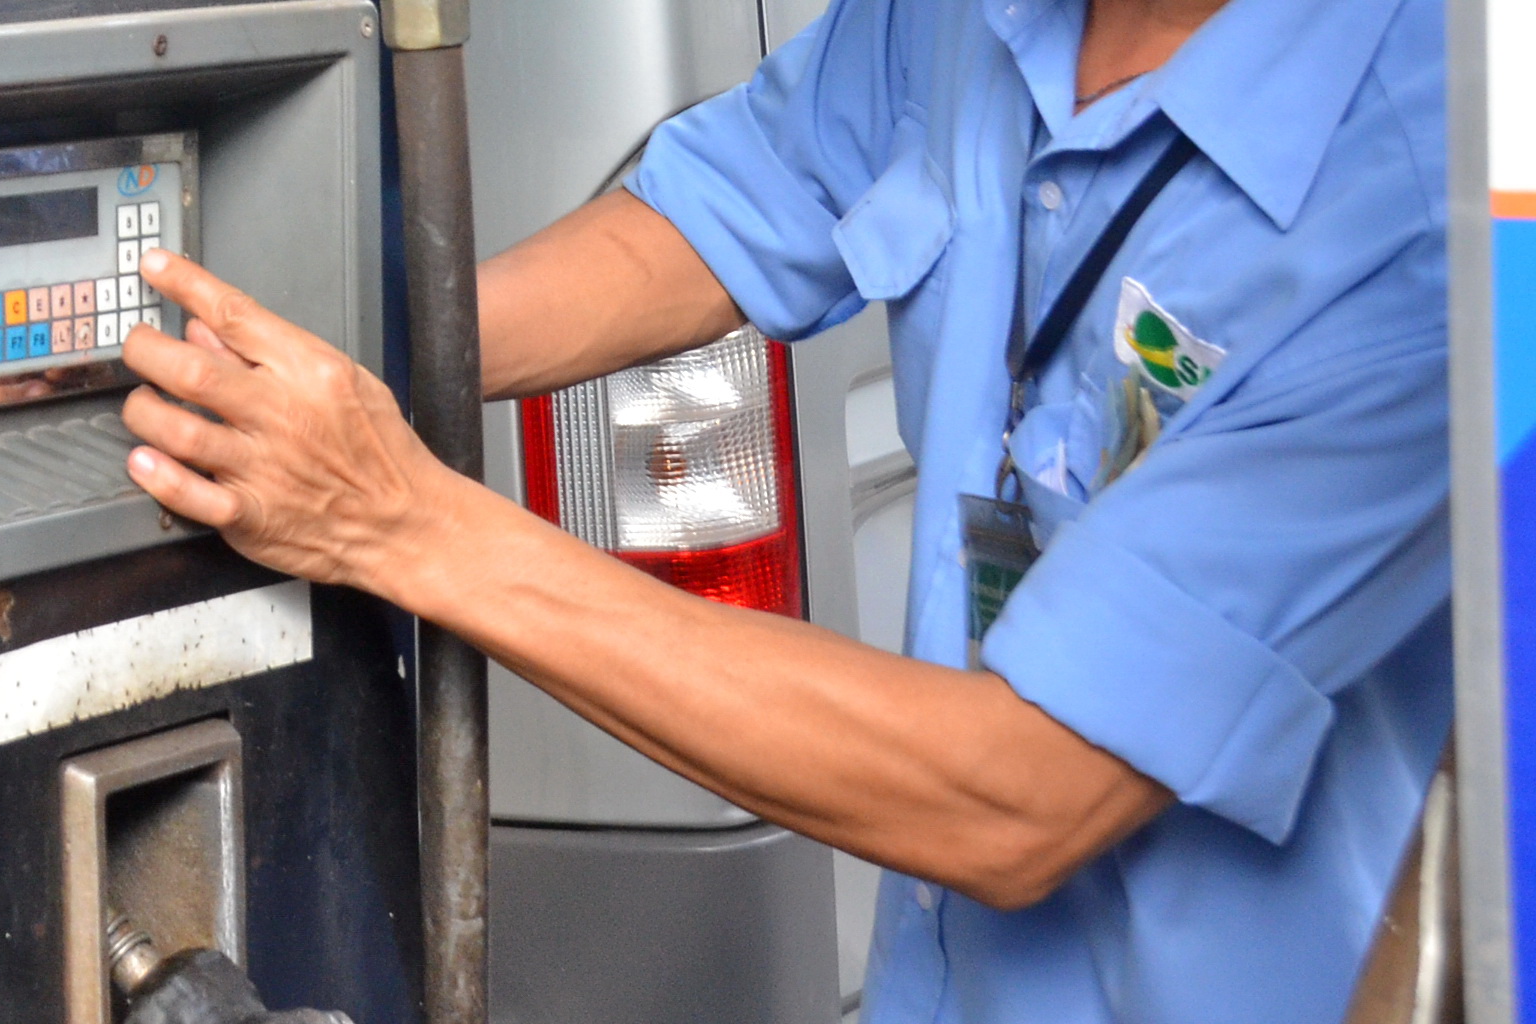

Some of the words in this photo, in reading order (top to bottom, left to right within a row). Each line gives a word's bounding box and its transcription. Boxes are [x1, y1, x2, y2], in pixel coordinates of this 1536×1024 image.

[147, 213, 153, 226] 9
[13, 301, 20, 314] C
[11, 336, 23, 350] F7
[33, 332, 45, 346] F8
